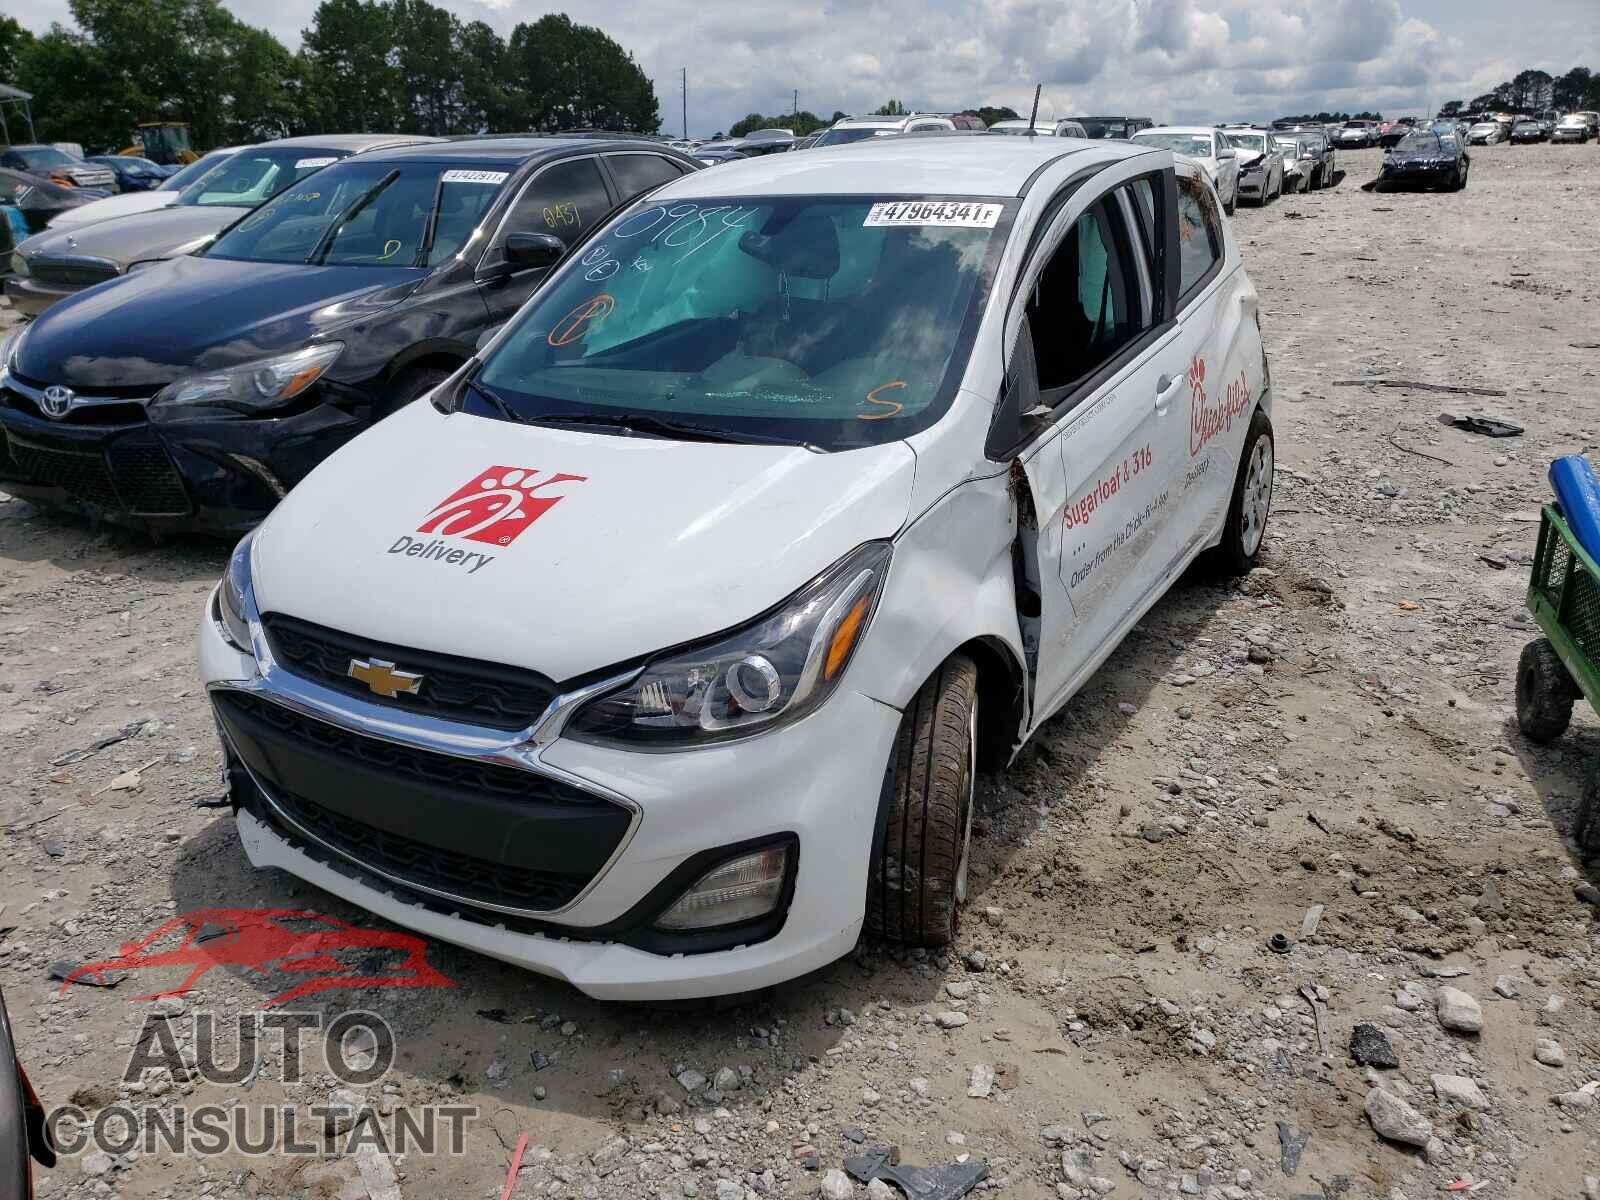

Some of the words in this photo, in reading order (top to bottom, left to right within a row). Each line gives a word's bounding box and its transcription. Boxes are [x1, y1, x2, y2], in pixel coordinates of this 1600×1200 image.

[884, 203, 981, 221] 47964341
[857, 381, 907, 421] S
[1063, 466, 1121, 530] Sugarloaf
[1123, 461, 1130, 482] &
[1133, 444, 1152, 475] 316
[388, 536, 496, 574] Delivery
[1071, 558, 1096, 588] Order
[1094, 544, 1113, 570] from
